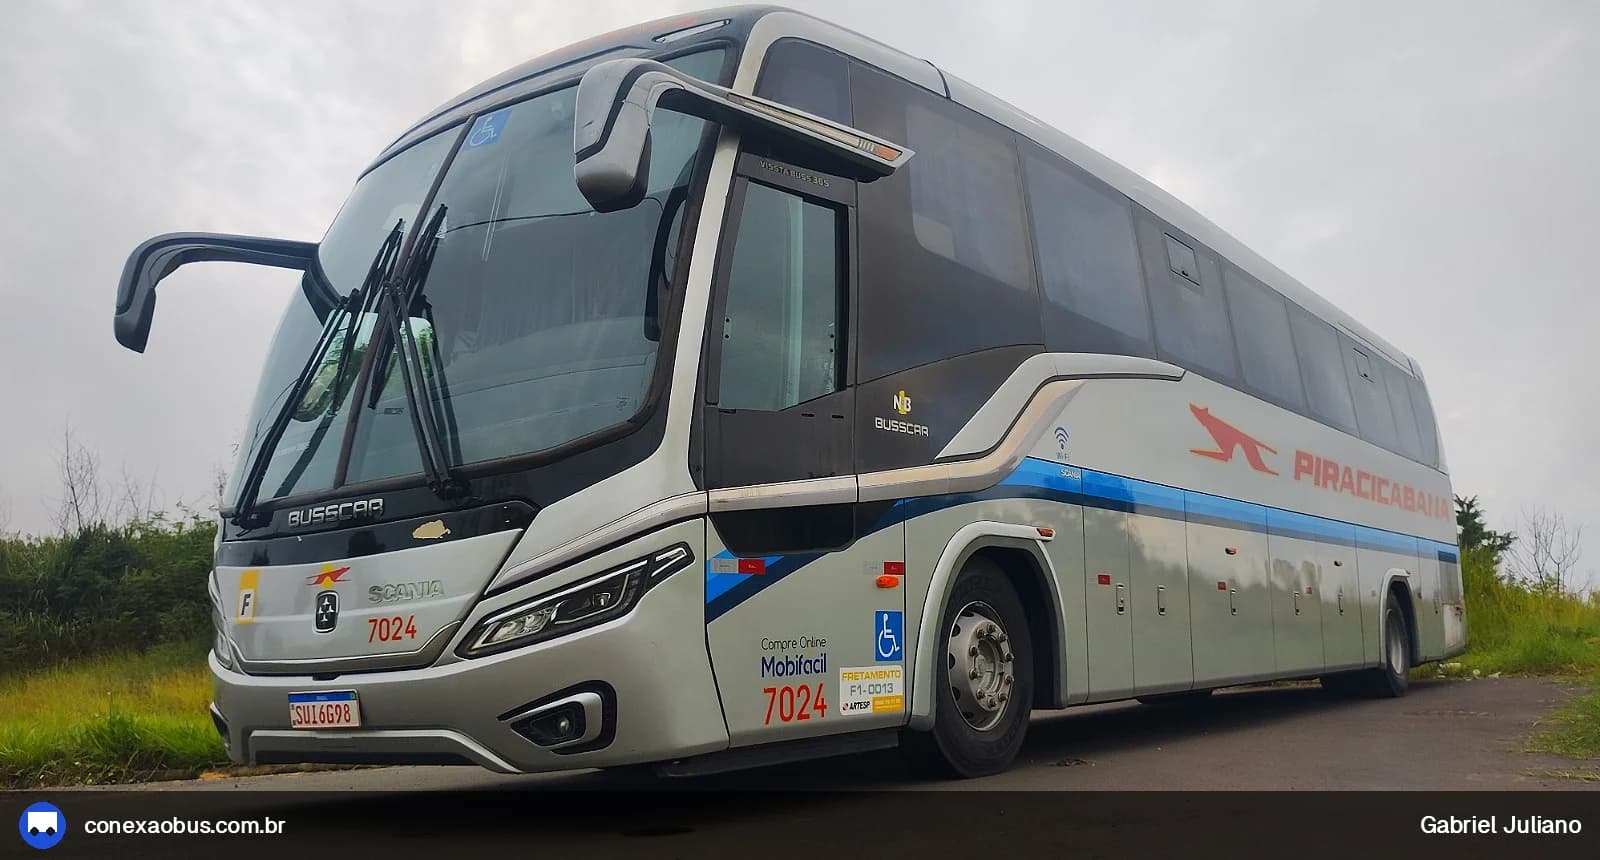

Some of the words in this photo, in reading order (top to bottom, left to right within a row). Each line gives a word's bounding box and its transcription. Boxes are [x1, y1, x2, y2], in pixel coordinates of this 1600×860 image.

[760, 160, 791, 176] VISSTA
[875, 416, 929, 437] BUSSCAR
[1294, 449, 1450, 520] PIRACICABANA
[288, 498, 384, 526] BUSSCAR
[368, 580, 445, 604] SCANIA
[240, 593, 252, 616] F
[368, 615, 417, 643] 7024
[761, 637, 798, 653] Compre
[799, 635, 827, 649] Online
[842, 669, 902, 681] FRETAMENTO
[850, 682, 894, 697] F1-0013
[295, 703, 351, 725] SUI6G98
[763, 683, 827, 725] 7024
[849, 700, 871, 710] ARTESP
